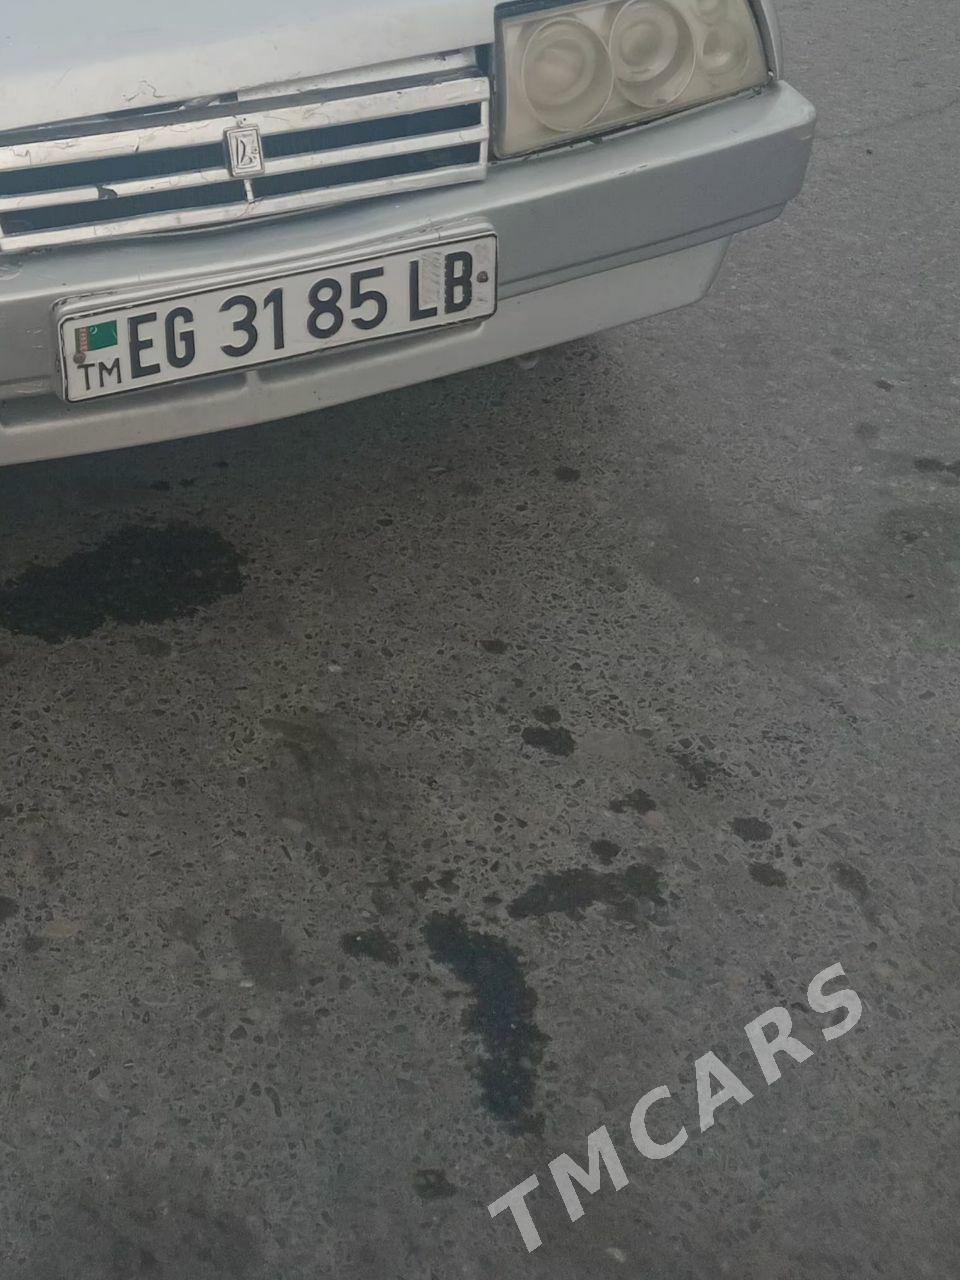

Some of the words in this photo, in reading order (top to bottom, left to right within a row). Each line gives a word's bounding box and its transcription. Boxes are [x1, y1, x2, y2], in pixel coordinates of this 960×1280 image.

[127, 306, 196, 379] EG
[409, 251, 473, 322] LB
[77, 358, 122, 390] TM
